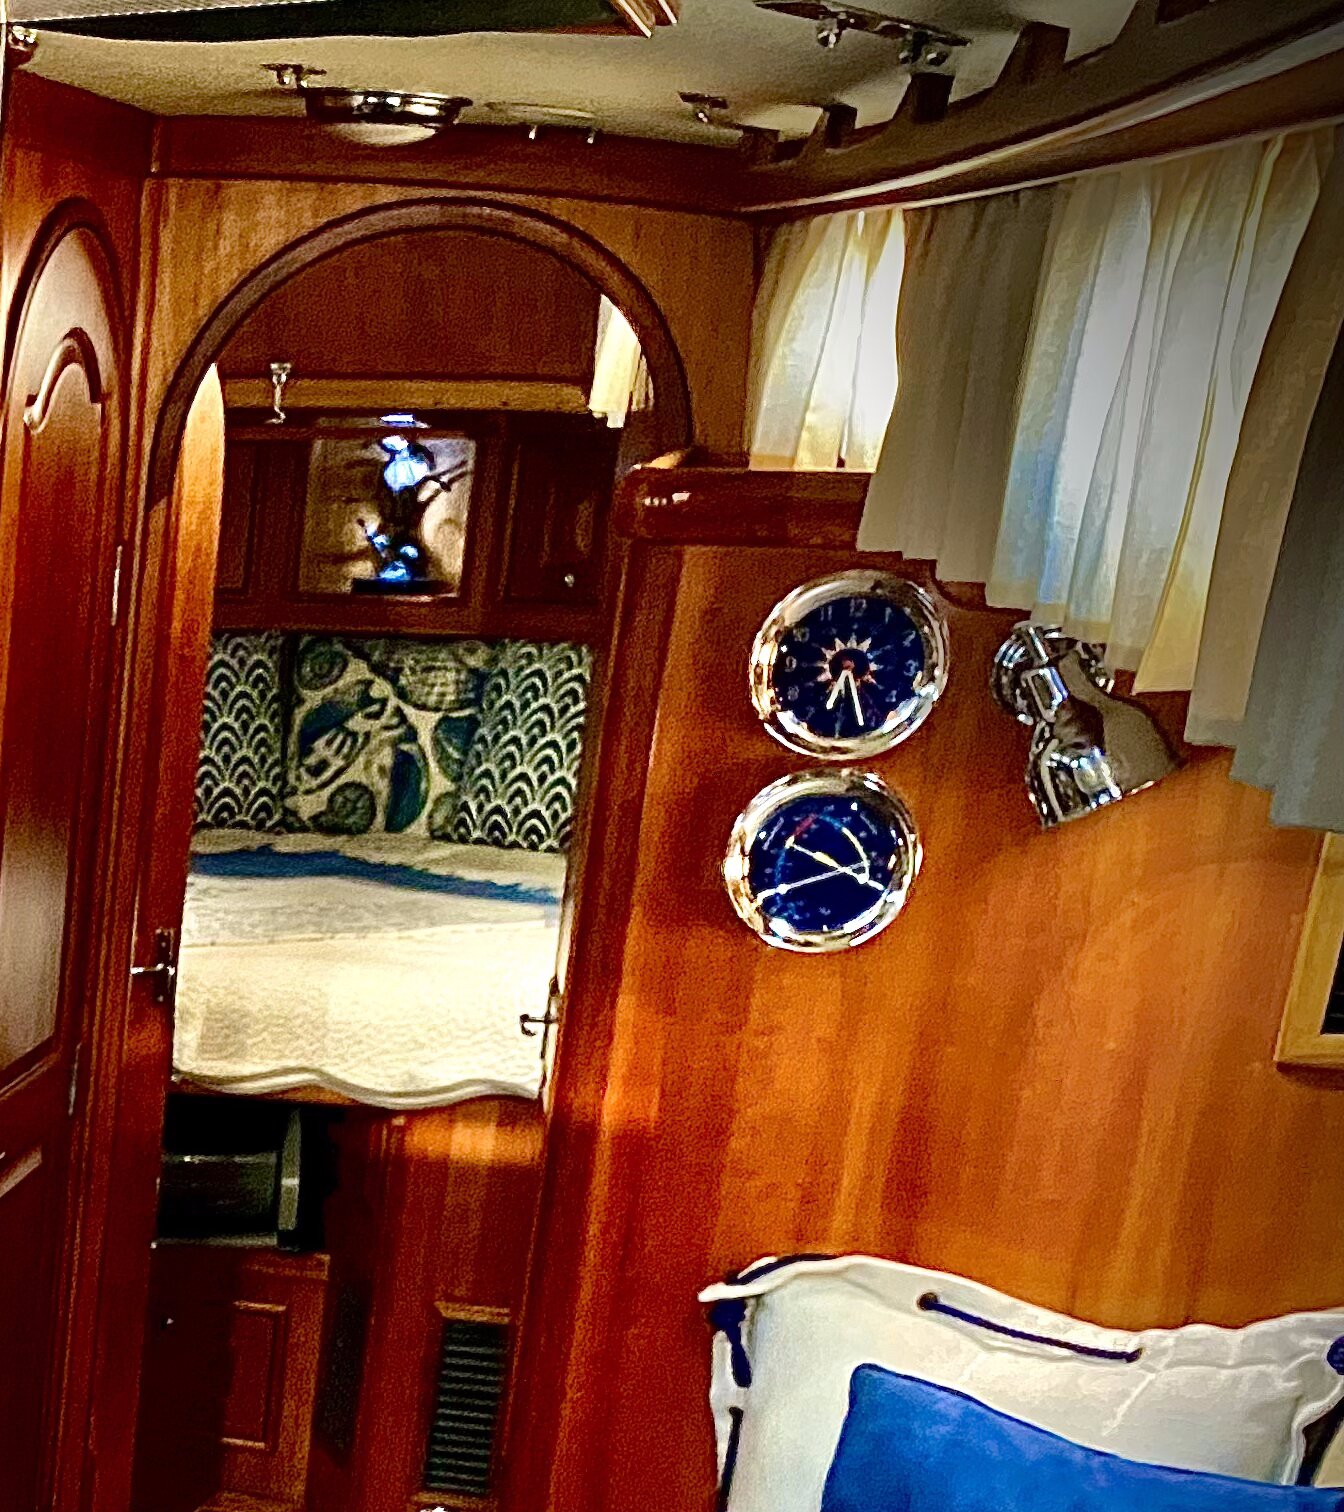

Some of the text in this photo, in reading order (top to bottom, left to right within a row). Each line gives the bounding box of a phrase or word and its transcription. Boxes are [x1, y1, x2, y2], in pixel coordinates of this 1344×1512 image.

[820, 605, 833, 621] 11
[850, 598, 867, 617] 12
[785, 656, 797, 672] 9
[904, 660, 918, 677] 3
